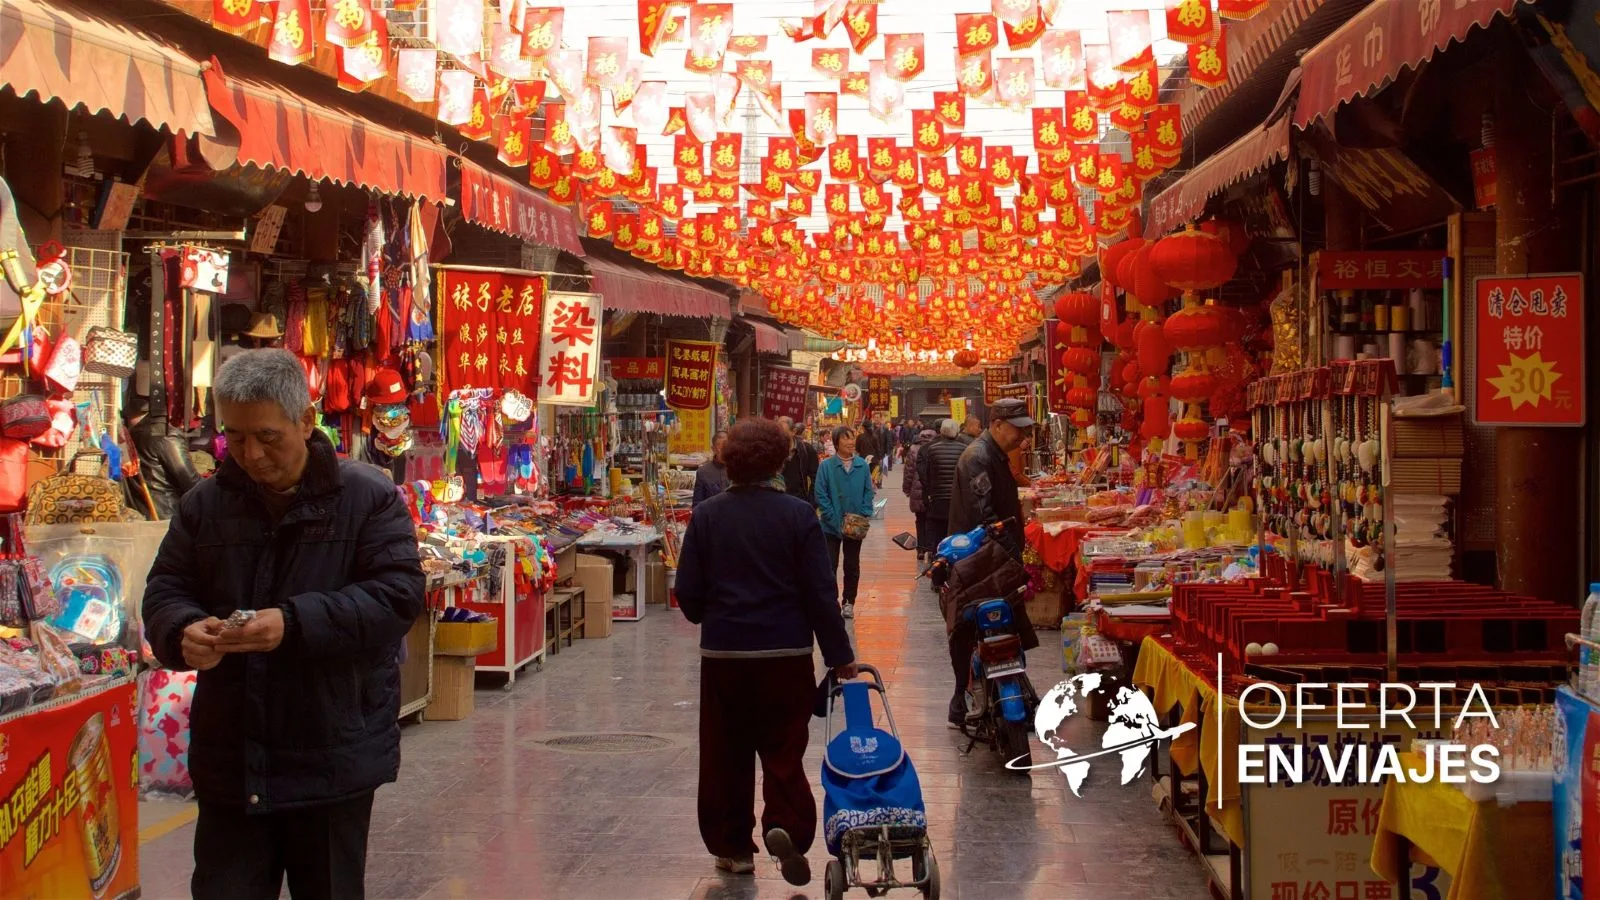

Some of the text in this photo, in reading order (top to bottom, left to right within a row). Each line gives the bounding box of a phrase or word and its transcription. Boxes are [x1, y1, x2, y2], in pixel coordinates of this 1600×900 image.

[334, 0, 365, 30] 福
[1177, 0, 1206, 28] 福
[277, 10, 304, 49] 福
[529, 20, 554, 50] 福
[967, 23, 993, 46] 福
[594, 52, 621, 77] 福
[819, 53, 842, 73] 福
[894, 45, 919, 72] 福
[1196, 45, 1220, 75] 福
[1129, 66, 1153, 98] 福
[942, 100, 961, 122] 福
[1072, 104, 1094, 132] 福
[552, 119, 573, 145] 福
[918, 121, 940, 147] 福
[1040, 122, 1060, 146] 福
[1156, 120, 1178, 146] 福
[504, 131, 524, 157] 福
[579, 149, 598, 167] 福
[680, 147, 698, 164] 福
[717, 145, 736, 167] 福
[774, 150, 793, 169] 福
[833, 148, 852, 171] 福
[874, 148, 893, 166] 福
[962, 144, 978, 166] 福
[1136, 144, 1154, 169] 福
[533, 155, 550, 179] 福
[897, 159, 916, 180] 福
[994, 158, 1011, 179] 福
[1080, 154, 1096, 178] 福
[556, 178, 571, 198] 福
[599, 167, 617, 189] 福
[767, 173, 782, 192] 福
[800, 172, 816, 187] 福
[929, 170, 946, 190] 福
[1100, 168, 1116, 187] 福
[864, 187, 880, 205] 福
[948, 189, 962, 206] 福
[966, 182, 981, 201] 福
[1052, 180, 1068, 200] 福
[663, 197, 678, 215] 福
[752, 204, 767, 217] 福
[792, 199, 805, 211] 福
[832, 195, 847, 212] 福
[593, 211, 606, 230] 福
[646, 217, 660, 236] 福
[683, 224, 696, 237] 福
[724, 215, 738, 231] 福
[851, 220, 863, 236] 福
[618, 225, 632, 241] 福
[703, 225, 715, 241] 福
[1334, 259, 1443, 280] 裕恒文具
[451, 282, 534, 317] 袜子老店
[1488, 285, 1568, 319] 清仓甩卖
[1503, 325, 1544, 350] 特价
[547, 301, 596, 397] 染料
[1509, 367, 1545, 394] 30
